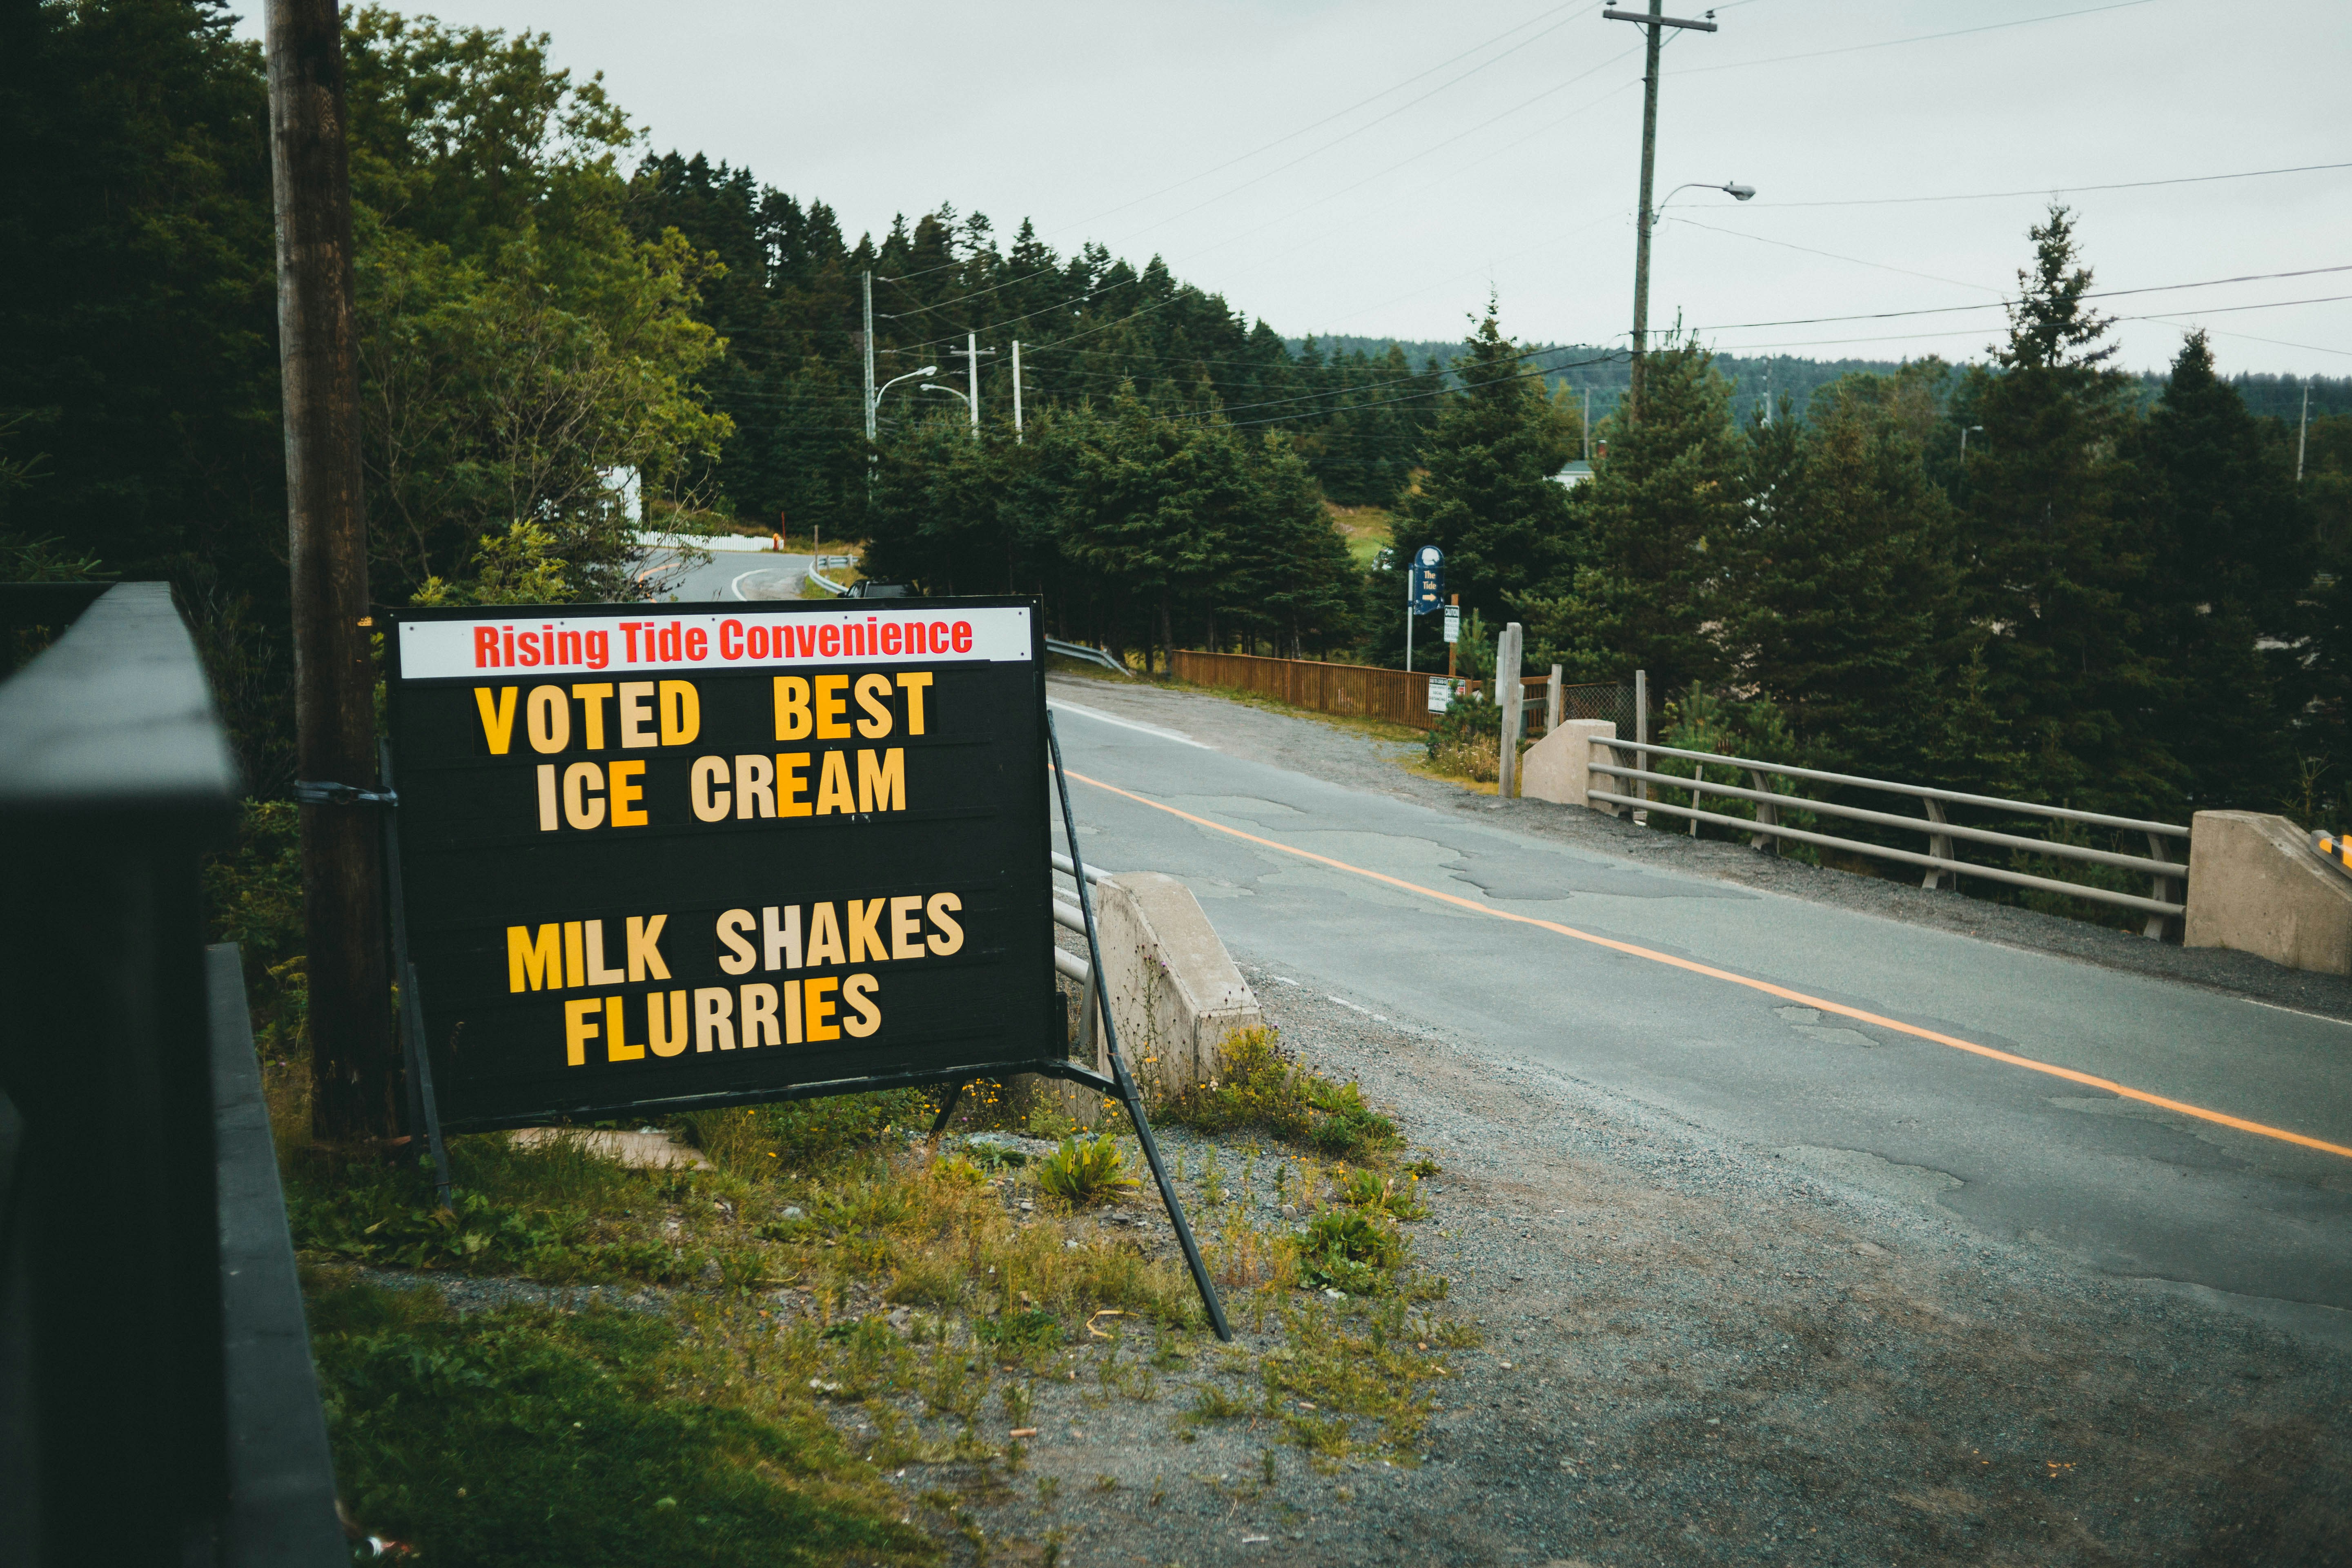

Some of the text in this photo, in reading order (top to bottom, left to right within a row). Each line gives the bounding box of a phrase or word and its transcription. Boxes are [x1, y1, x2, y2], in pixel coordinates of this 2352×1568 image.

[1423, 581, 1437, 589] Tide
[1424, 570, 1436, 579] The
[474, 617, 972, 669] Rising Tide Convenience
[1445, 608, 1459, 616] CAUTION
[474, 672, 933, 755] VOTED BEST
[537, 748, 906, 831] ICE CREAM
[507, 892, 964, 993] MILK SHAKES
[565, 973, 881, 1066] FLURRIES
